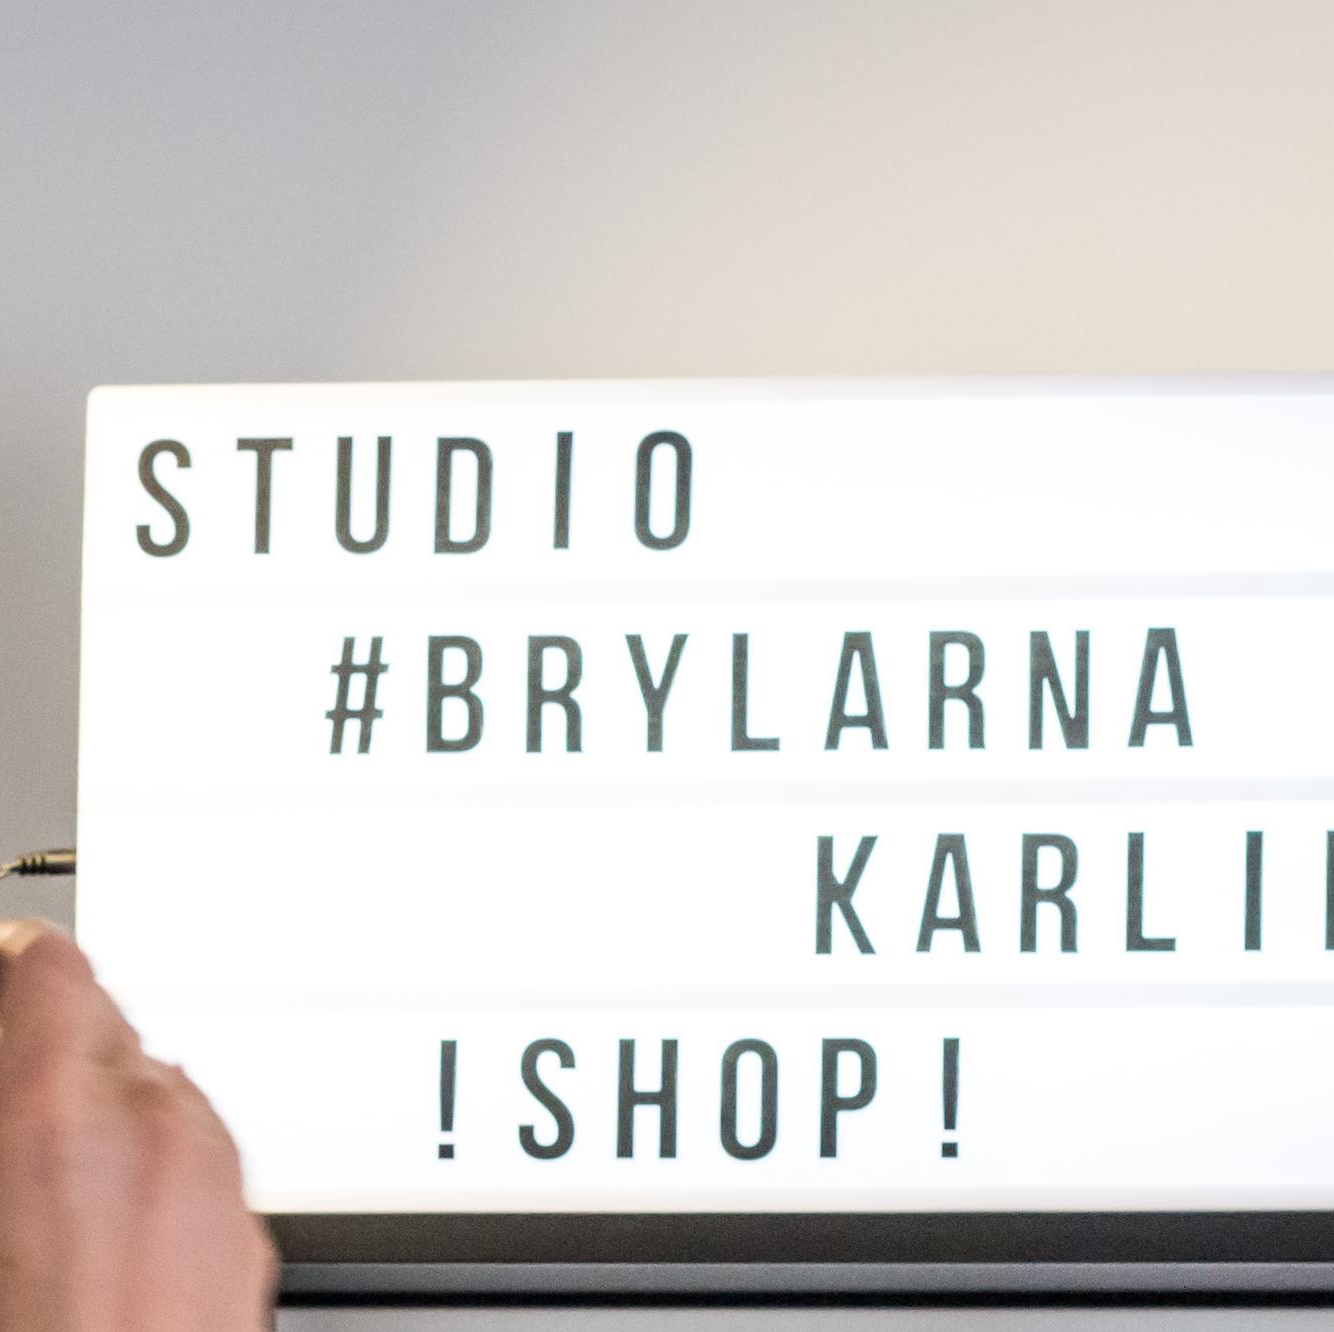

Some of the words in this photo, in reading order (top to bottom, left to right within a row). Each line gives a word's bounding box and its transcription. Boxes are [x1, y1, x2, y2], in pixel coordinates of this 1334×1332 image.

[136, 431, 693, 557] STUDIO
[325, 628, 1194, 755] #BRYLARNA
[439, 1038, 962, 1161] !SHOP!
